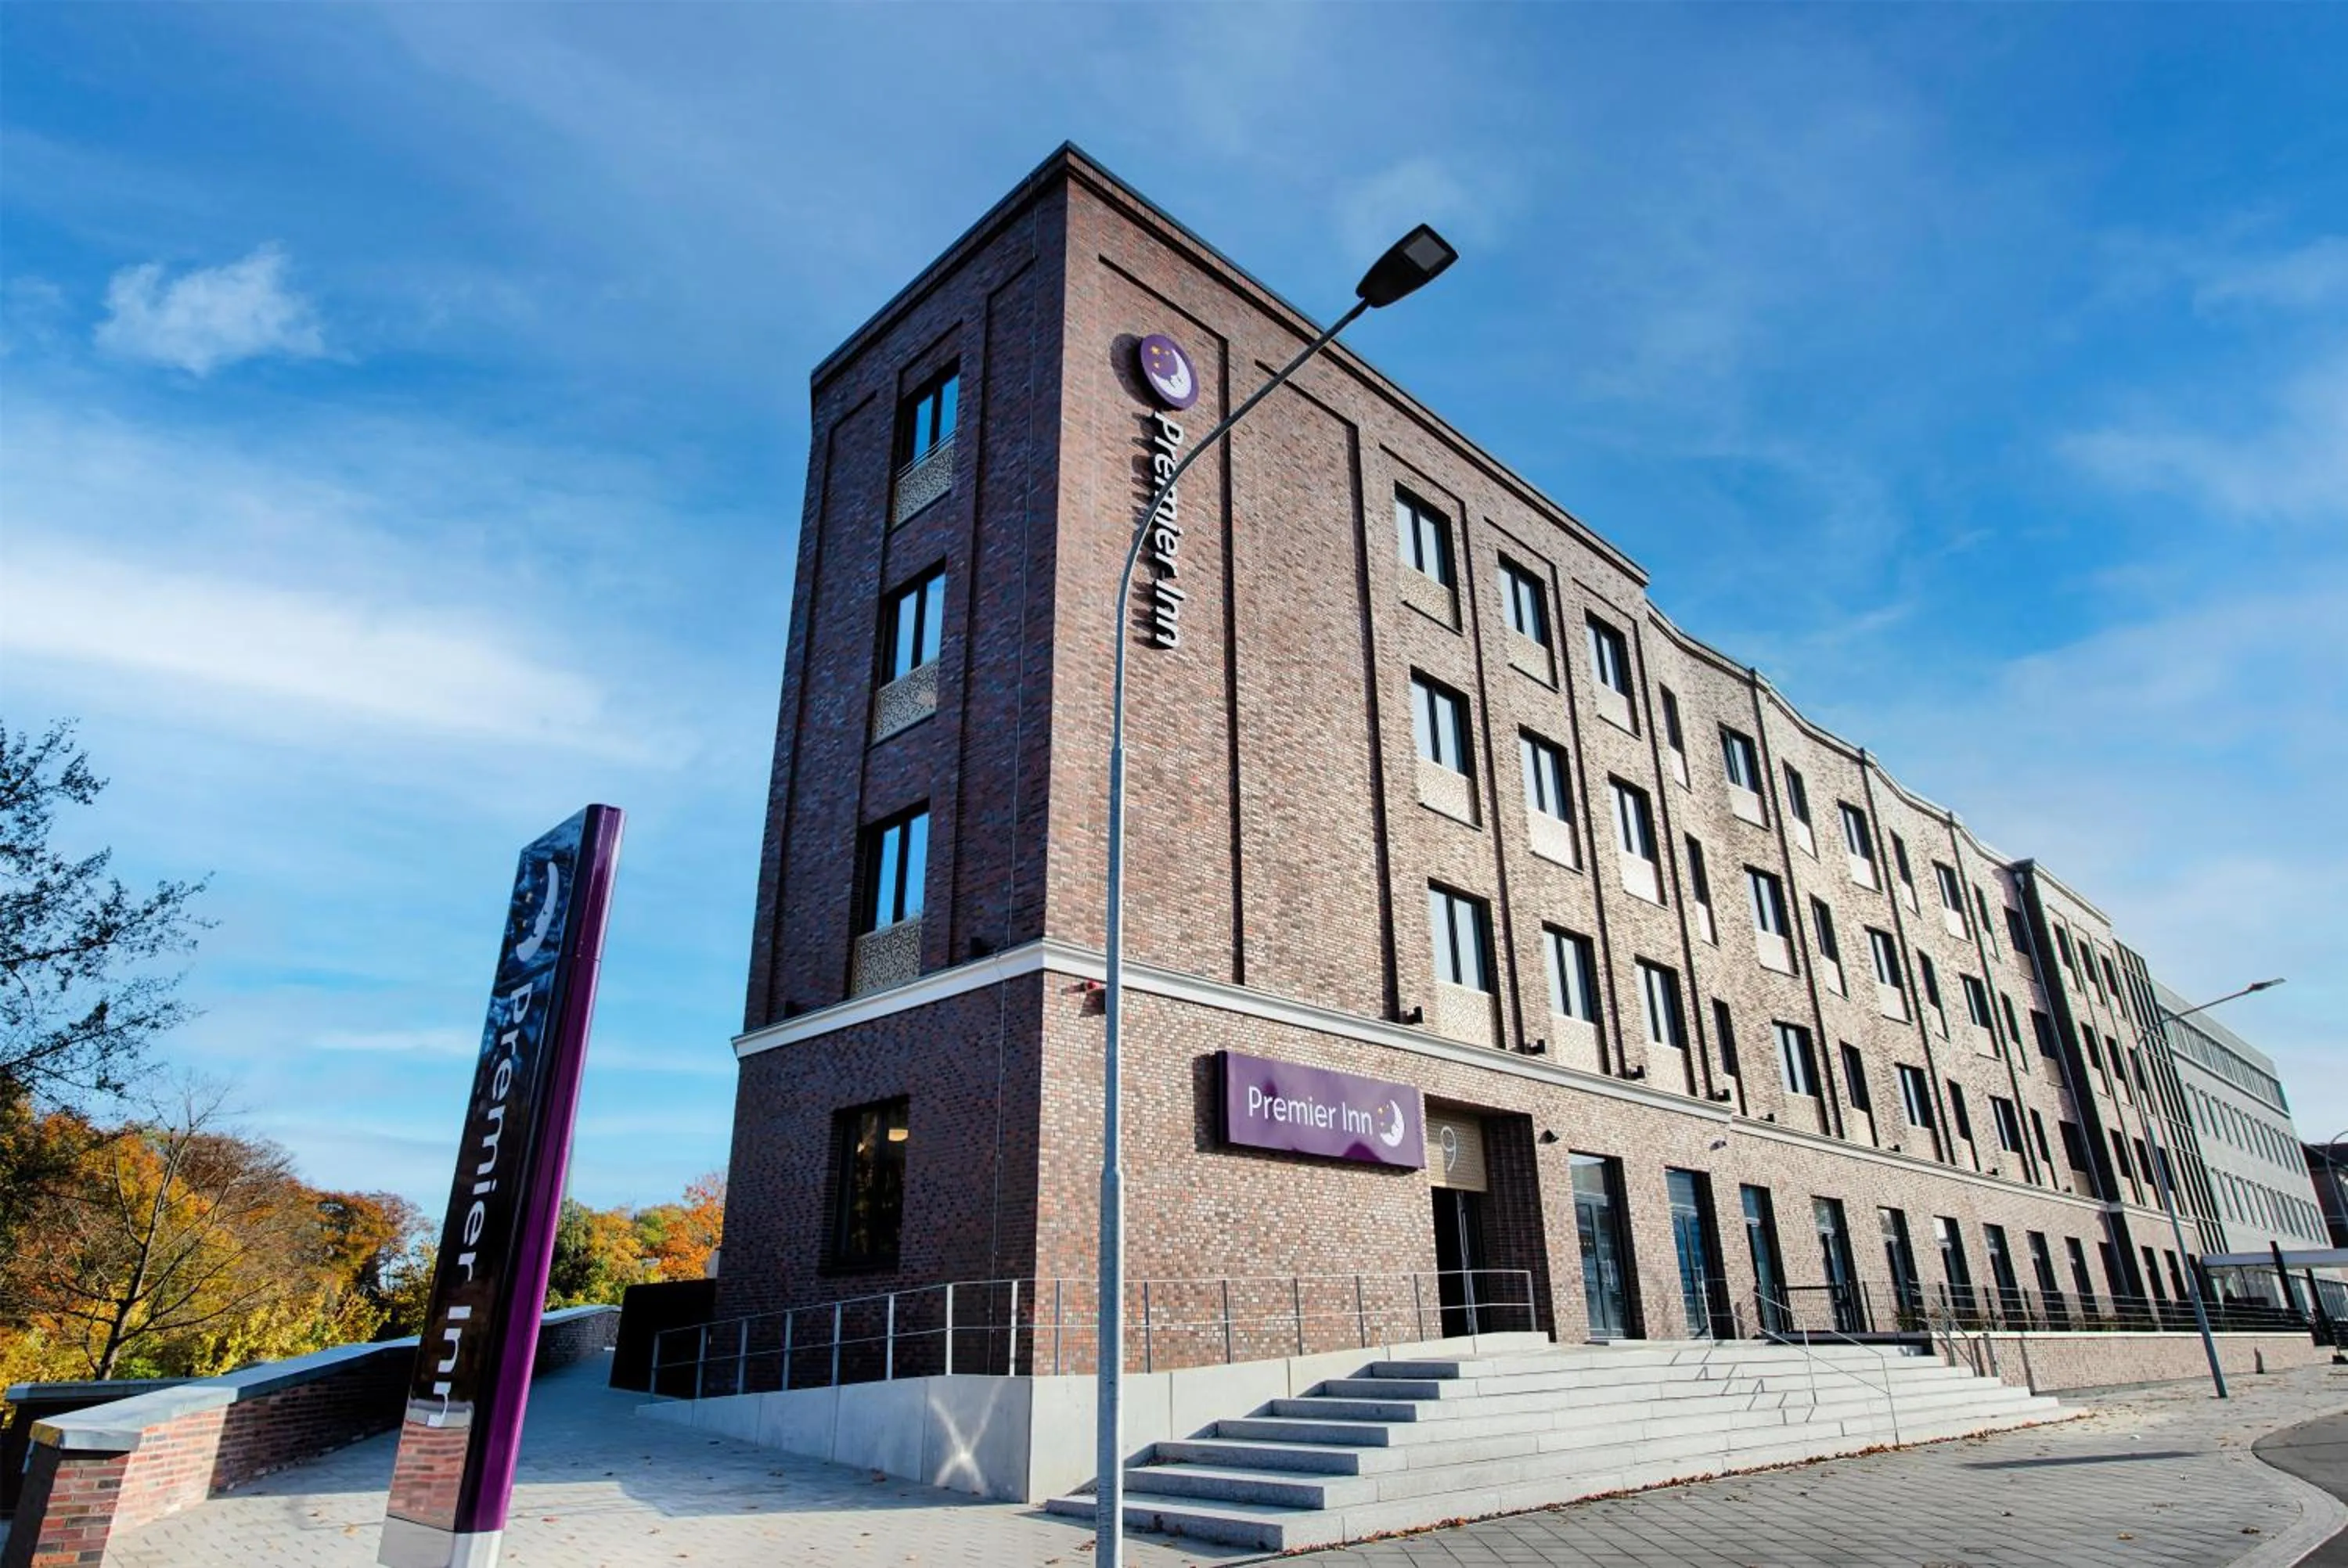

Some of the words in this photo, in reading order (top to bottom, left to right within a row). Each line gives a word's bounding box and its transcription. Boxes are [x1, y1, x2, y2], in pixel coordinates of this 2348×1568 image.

[1155, 579, 1185, 649] Inn
[458, 982, 533, 1282] Premier
[1248, 1085, 1335, 1129] Premier
[1342, 1101, 1373, 1136] Inn
[1440, 1125, 1457, 1172] 9
[427, 1306, 472, 1427] Inn
